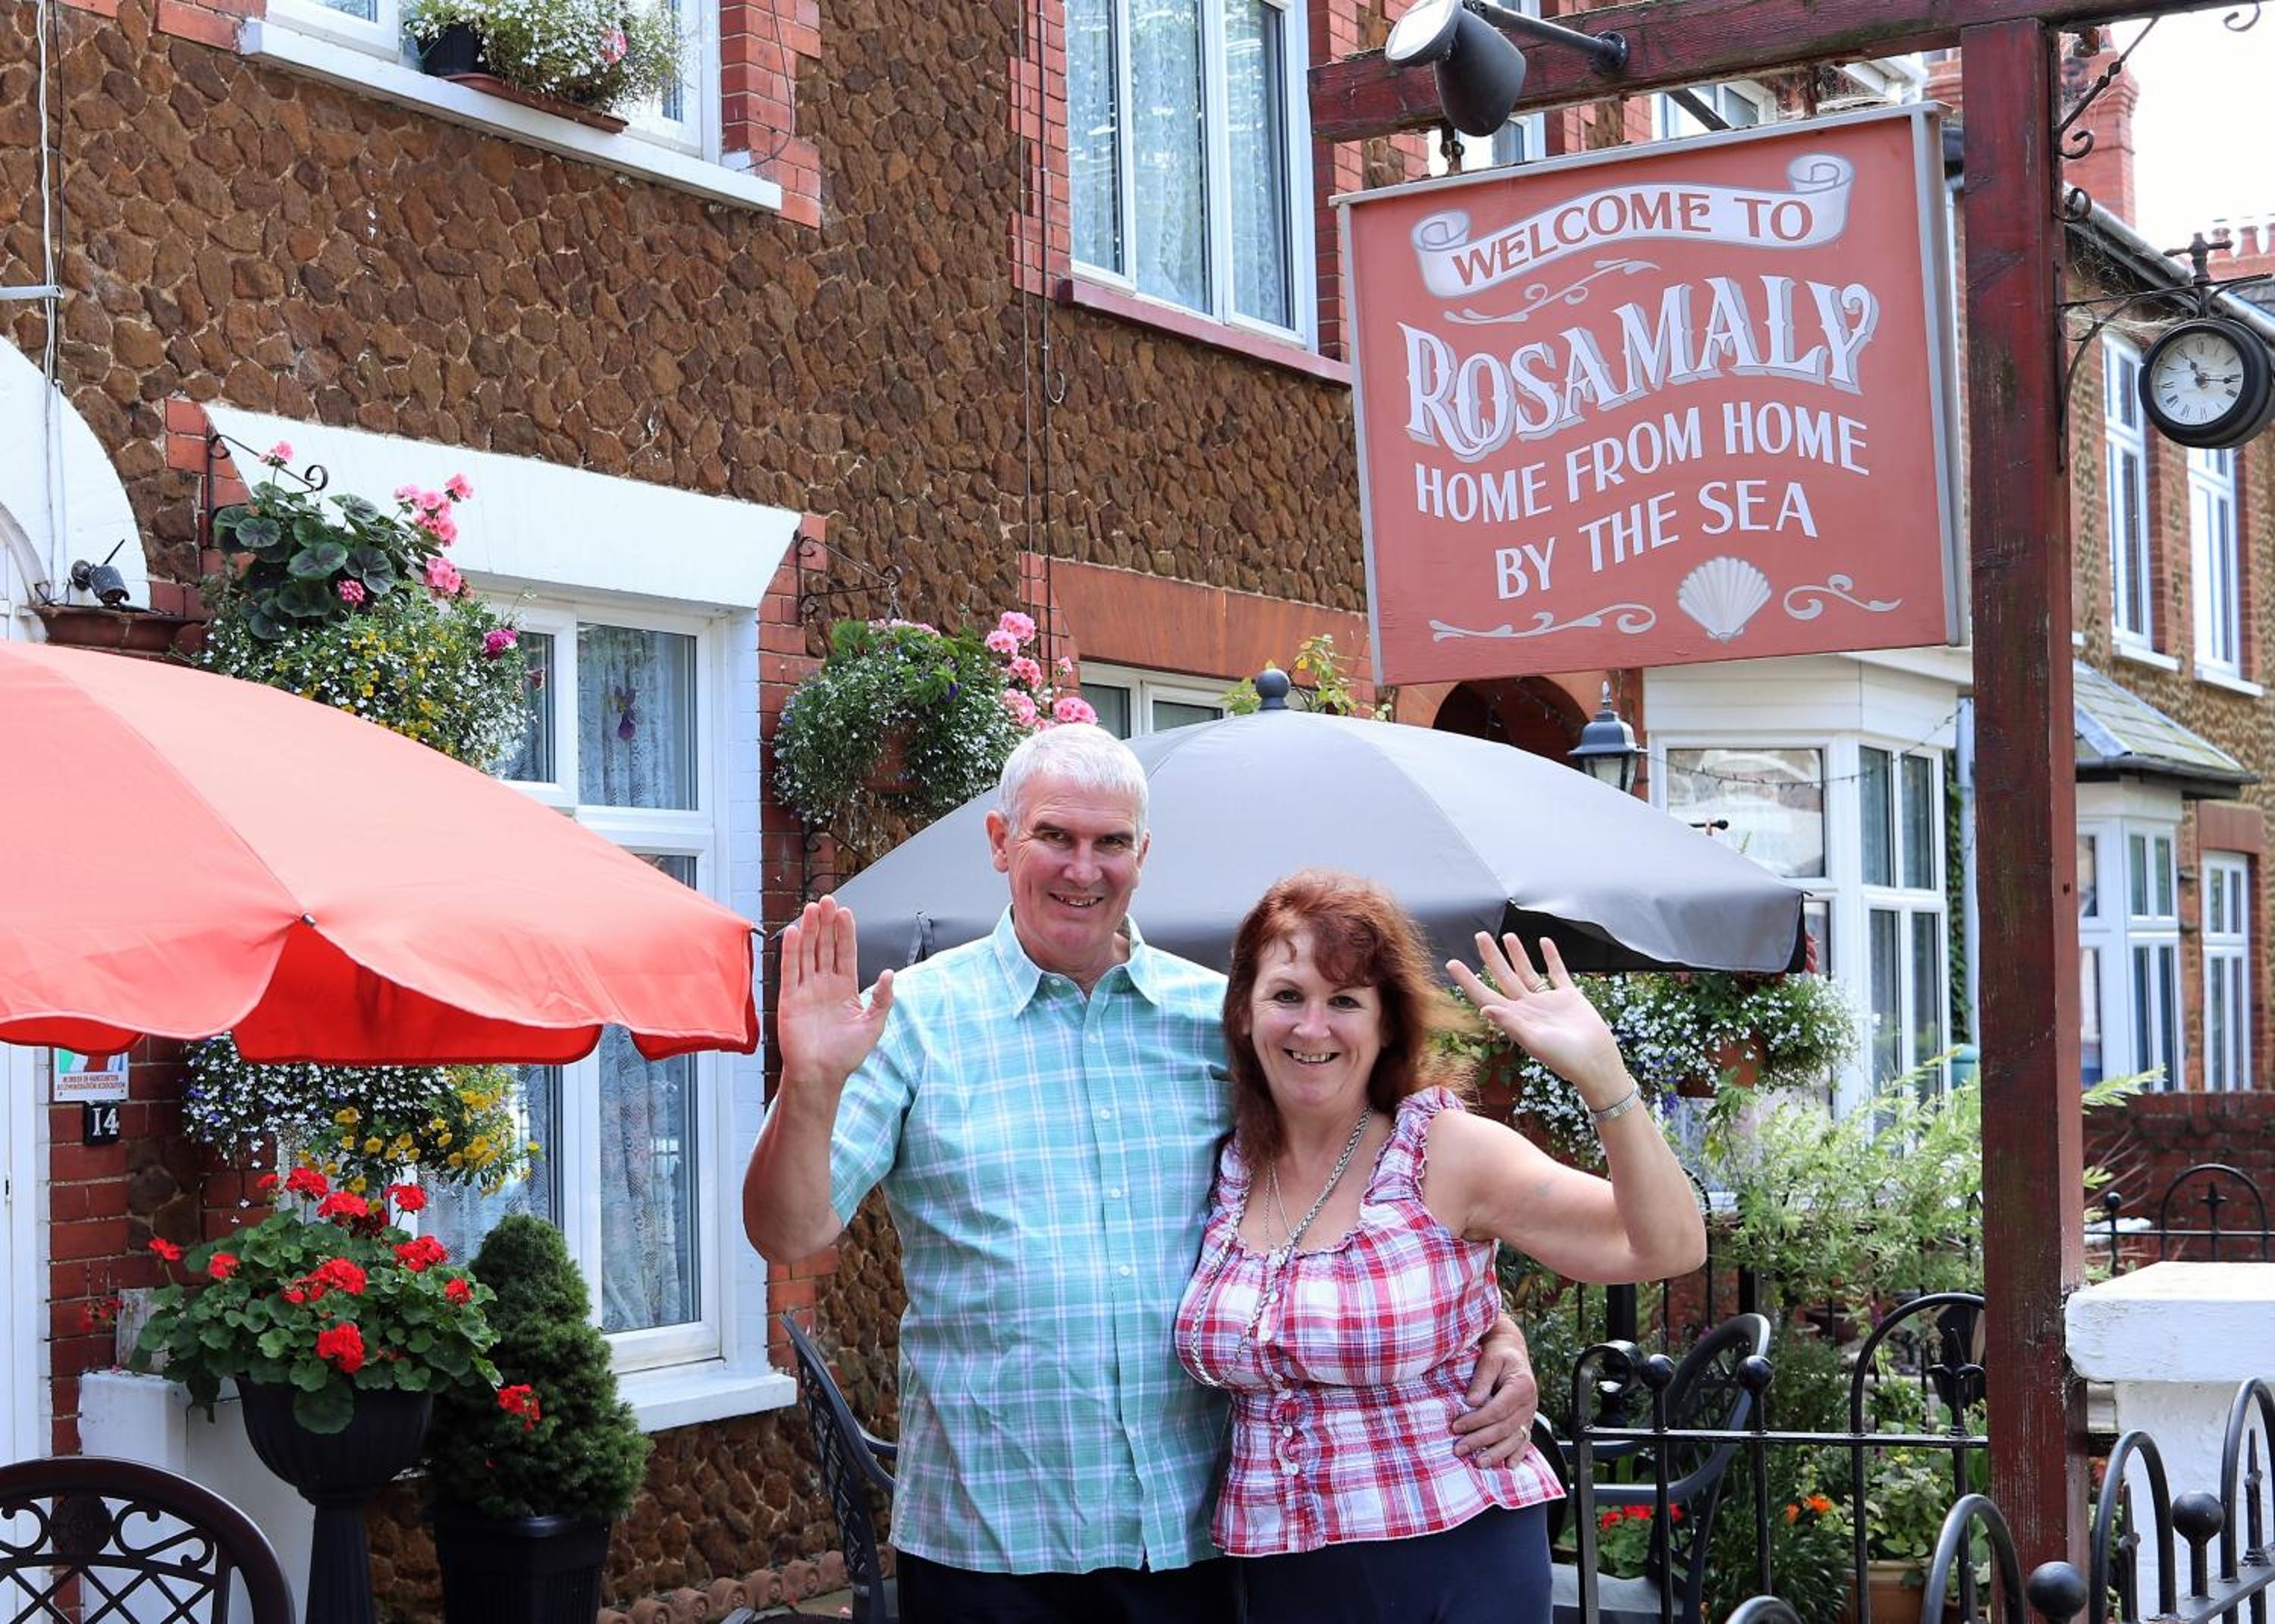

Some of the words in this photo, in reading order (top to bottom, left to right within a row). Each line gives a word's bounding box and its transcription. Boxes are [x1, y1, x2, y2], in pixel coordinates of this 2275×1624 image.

[1451, 192, 1712, 286] WELCOME
[1734, 196, 1813, 242] TO
[1397, 274, 1878, 462] ROSAMALY
[1414, 461, 1552, 524] HOME
[1564, 406, 1702, 503] FROM
[1722, 401, 1869, 475] HOME
[1495, 537, 1556, 600] BY
[1578, 491, 1680, 573] THE
[1698, 480, 1818, 538] SEA
[93, 1108, 120, 1136] 14
